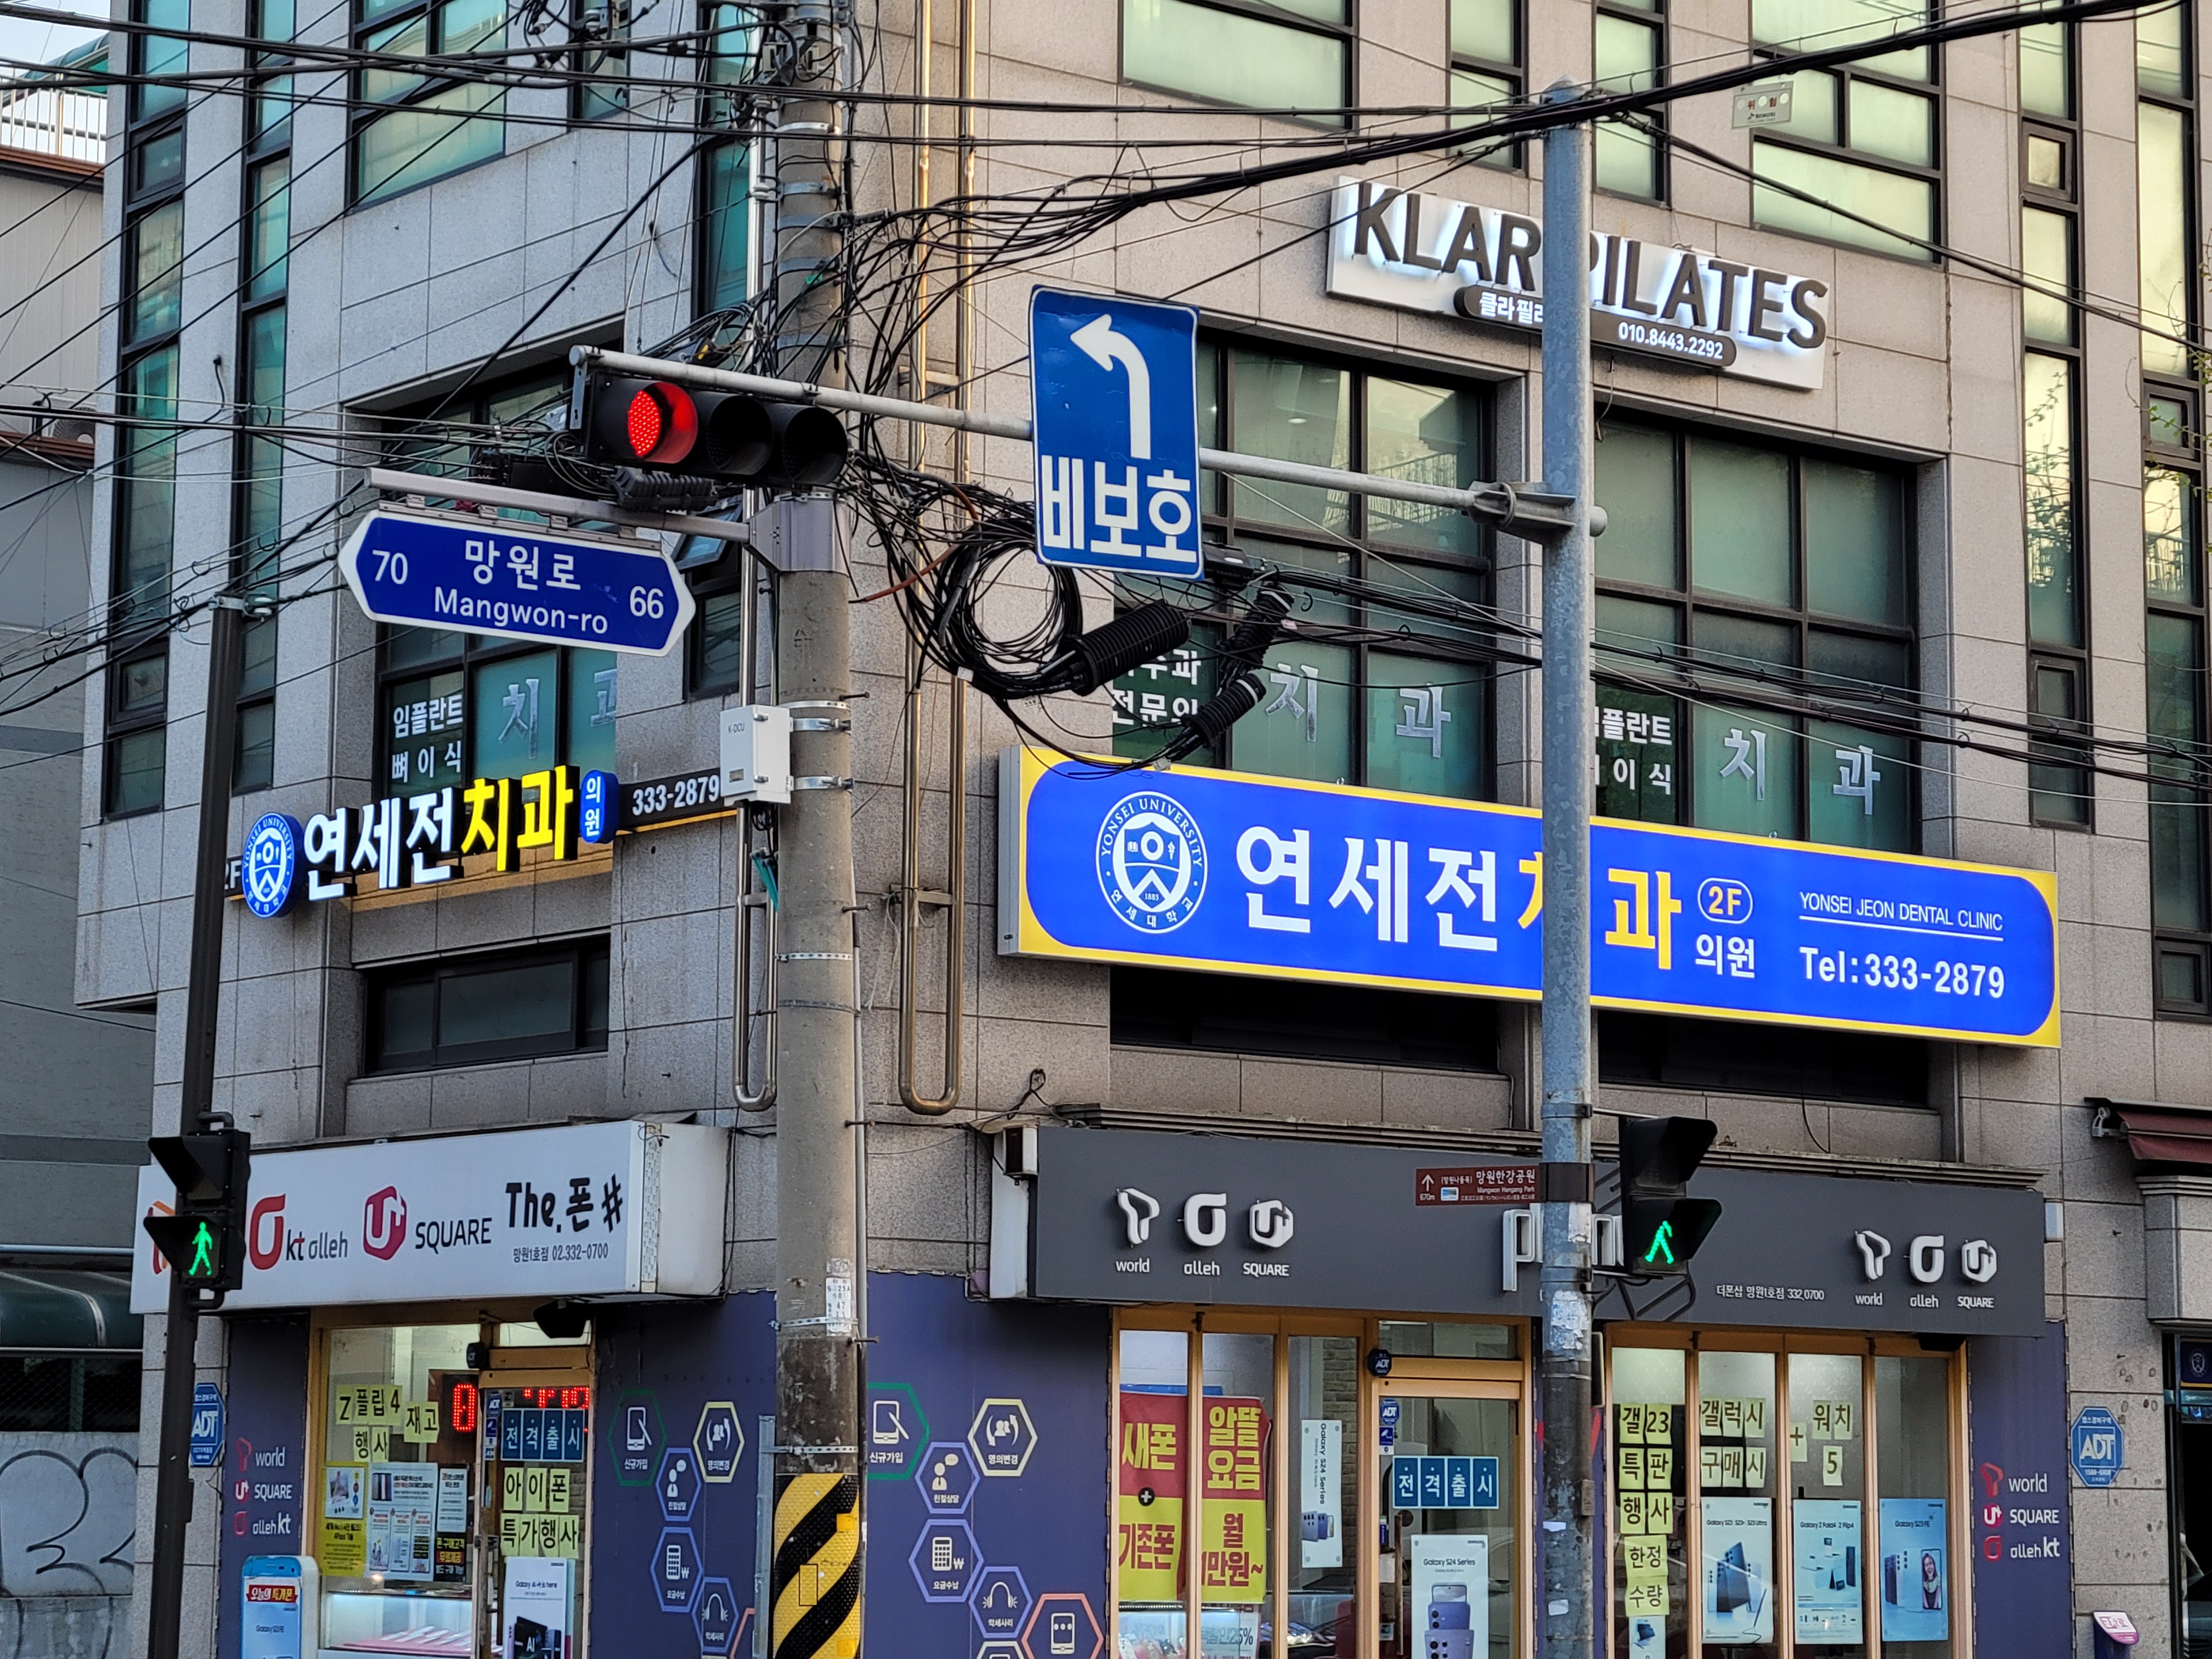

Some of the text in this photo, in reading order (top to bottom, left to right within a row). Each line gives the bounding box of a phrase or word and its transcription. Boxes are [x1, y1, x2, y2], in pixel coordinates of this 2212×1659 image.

[1353, 182, 1829, 349] KLAR ILATES
[1618, 321, 1723, 359] 010.8443.2292
[1041, 455, 1197, 562] 비보호
[372, 540, 664, 619] 70 망원로 66
[435, 586, 608, 634] Mangwon-ro
[393, 694, 463, 738] 임플란트
[728, 721, 745, 733] K-DCU
[632, 774, 720, 816] 333-2879
[1101, 798, 1202, 867] YONSEI UNIVERSITY
[1708, 886, 1742, 916] 2F
[1800, 891, 2004, 932] YONSEI JEON DENTAL CLINIC
[1695, 934, 1755, 979] 의원
[1476, 1169, 1535, 1184] 망원한강공원
[309, 1231, 348, 1260] olleh
[415, 1217, 492, 1254] SQUARE
[1115, 1258, 1290, 1278] world olleh SQUARE
[1716, 1284, 1743, 1298] 더폰샵
[1746, 1286, 1785, 1300] 망원1호점
[1855, 1293, 1994, 1310] world olleh SQUARE
[1375, 1359, 1390, 1368] ADT
[191, 1410, 218, 1437] ADT
[406, 1406, 438, 1435] 재고
[1383, 1407, 1397, 1417] ADT
[1701, 1401, 1763, 1430] 갤럭시
[1813, 1404, 1851, 1432] 워치
[506, 1426, 579, 1451] 전격출시
[1209, 1406, 1261, 1447] 알뜰
[255, 1447, 285, 1467] world
[870, 1452, 903, 1463] 신규가입
[988, 1454, 1018, 1465] 명의변경
[1122, 1423, 1177, 1470] 새폰
[2080, 1434, 2115, 1460] ADT
[1207, 1449, 1260, 1491] 요금
[1622, 1453, 1669, 1481] 특판
[1702, 1451, 1764, 1480] 구매시
[1827, 1452, 1838, 1474] 5
[254, 1484, 292, 1502] SQUARE
[506, 1471, 567, 1502] 아이폰
[1398, 1474, 1492, 1498] 전격출시
[2008, 1473, 2047, 1493] world
[1623, 1497, 1667, 1525] 행사
[2010, 1509, 2059, 1526] SQUARE
[502, 1519, 578, 1550] 특가행사
[1223, 1513, 1244, 1549] 월
[1119, 1523, 1175, 1570] 기존폰
[1629, 1545, 1661, 1568] 한정
[1424, 1559, 1445, 1567] Galaxy
[933, 1581, 959, 1590] 요금수납
[1629, 1584, 1663, 1608] 수량
